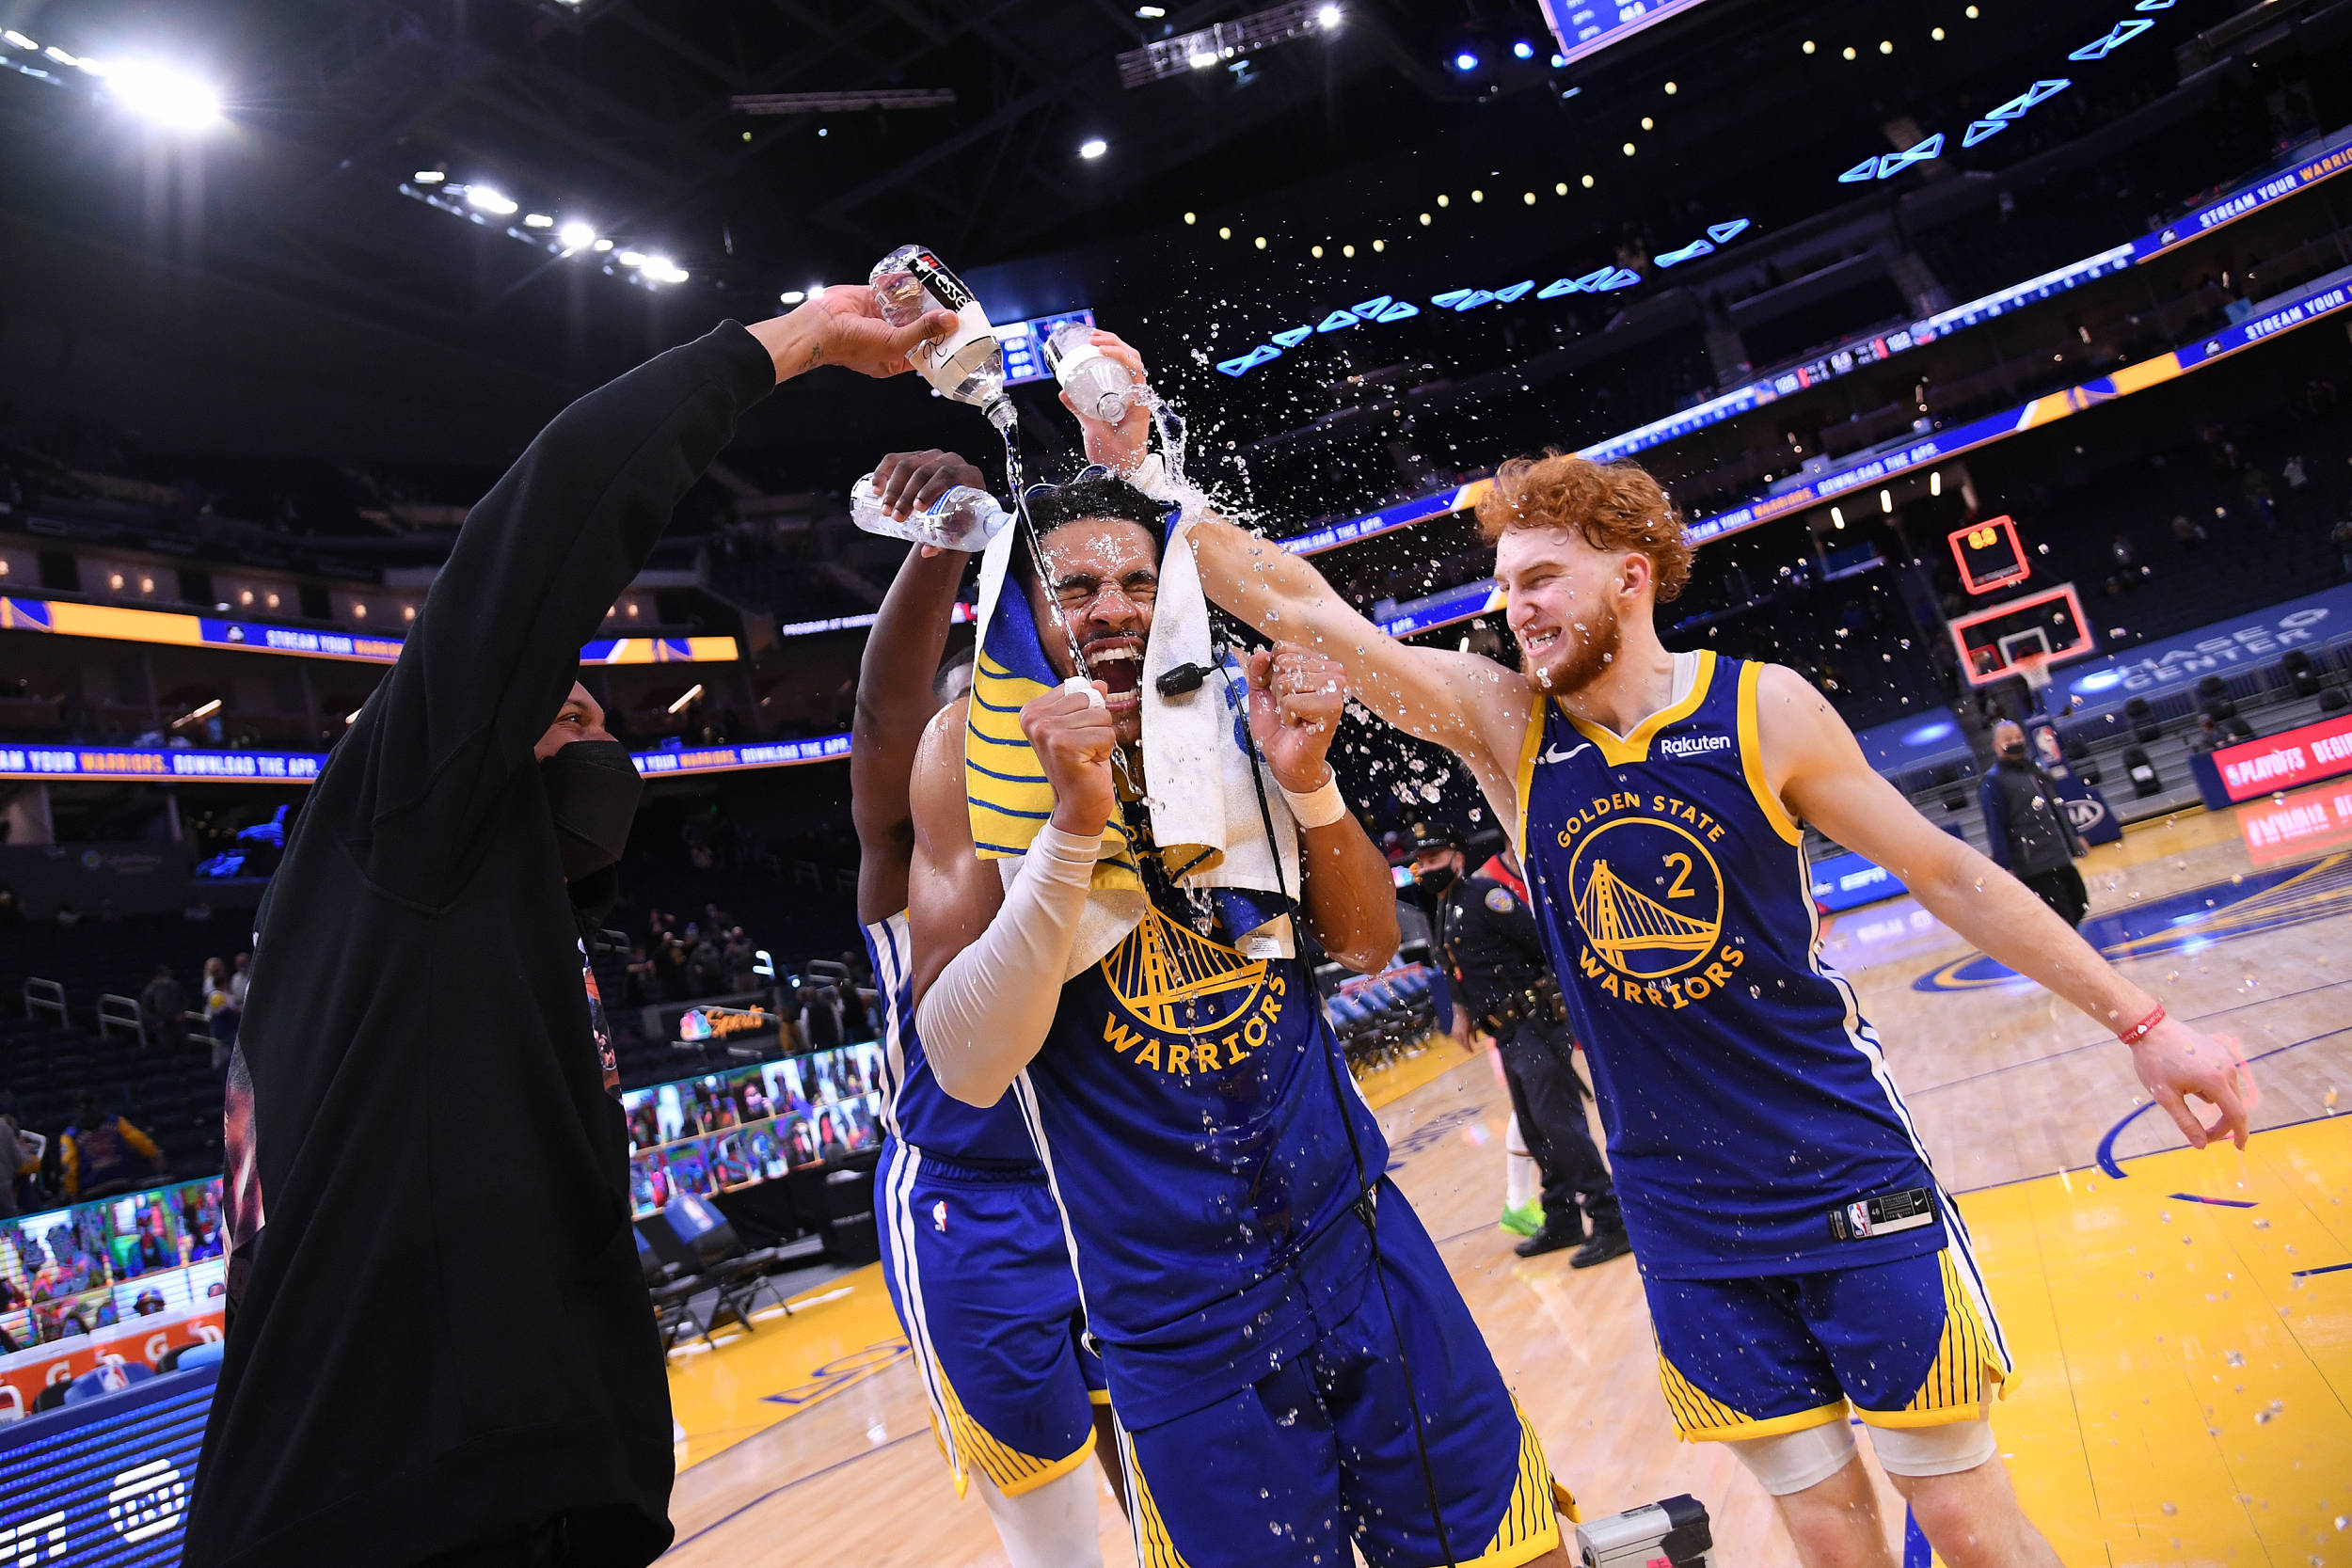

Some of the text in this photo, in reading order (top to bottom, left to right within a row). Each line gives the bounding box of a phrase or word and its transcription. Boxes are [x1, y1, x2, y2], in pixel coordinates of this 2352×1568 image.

[2199, 192, 2257, 229] STREAM
[2257, 174, 2297, 201] YOUR
[2244, 289, 2345, 341] STREAM YOUR
[1719, 508, 1752, 529] YOUR
[1817, 461, 1883, 497] DOWNLOAD
[1883, 451, 1909, 471] THE
[1336, 523, 1359, 541] THE
[266, 630, 319, 652] STREAM
[319, 635, 353, 655] YOUR
[2123, 627, 2313, 691] CENTER
[28, 751, 77, 772] YOUR
[173, 753, 256, 775] DOWNLOAD
[257, 756, 286, 776] THE
[645, 754, 677, 771] YOUR
[740, 744, 799, 764] DOWNLOAD
[800, 741, 821, 758] THE
[1661, 735, 1731, 753] Rakuten
[2238, 746, 2307, 785] PLAYOFFS
[1557, 791, 1725, 848] GOLDEN STATE
[1665, 852, 1695, 899] 2
[1580, 944, 1745, 1010] WARRIORS
[1101, 972, 1286, 1074] WARRIORS
